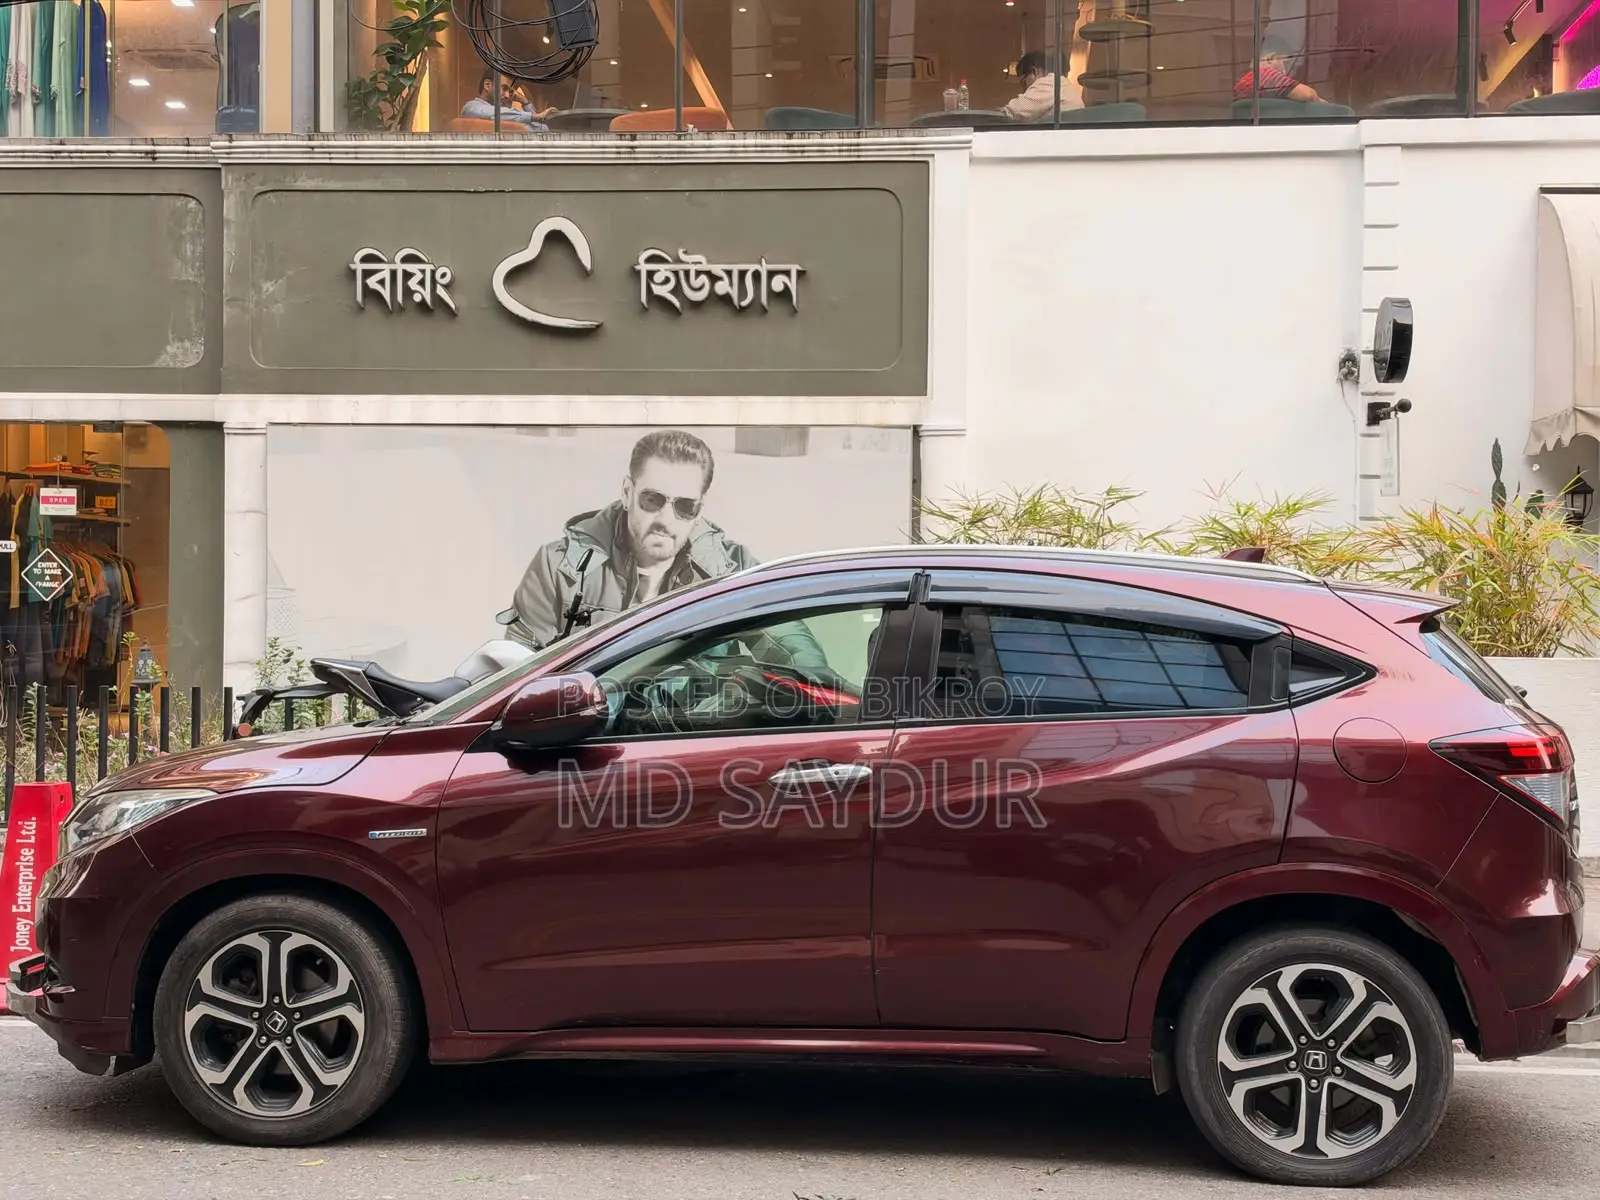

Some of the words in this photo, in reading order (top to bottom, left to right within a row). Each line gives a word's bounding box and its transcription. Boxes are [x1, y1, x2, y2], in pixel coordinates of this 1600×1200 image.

[349, 246, 458, 316] বিয়িং
[635, 247, 806, 314] হিউম্যান
[16, 816, 37, 844] Ltd.
[12, 847, 36, 913] Enterprise
[10, 917, 34, 952] Joney
